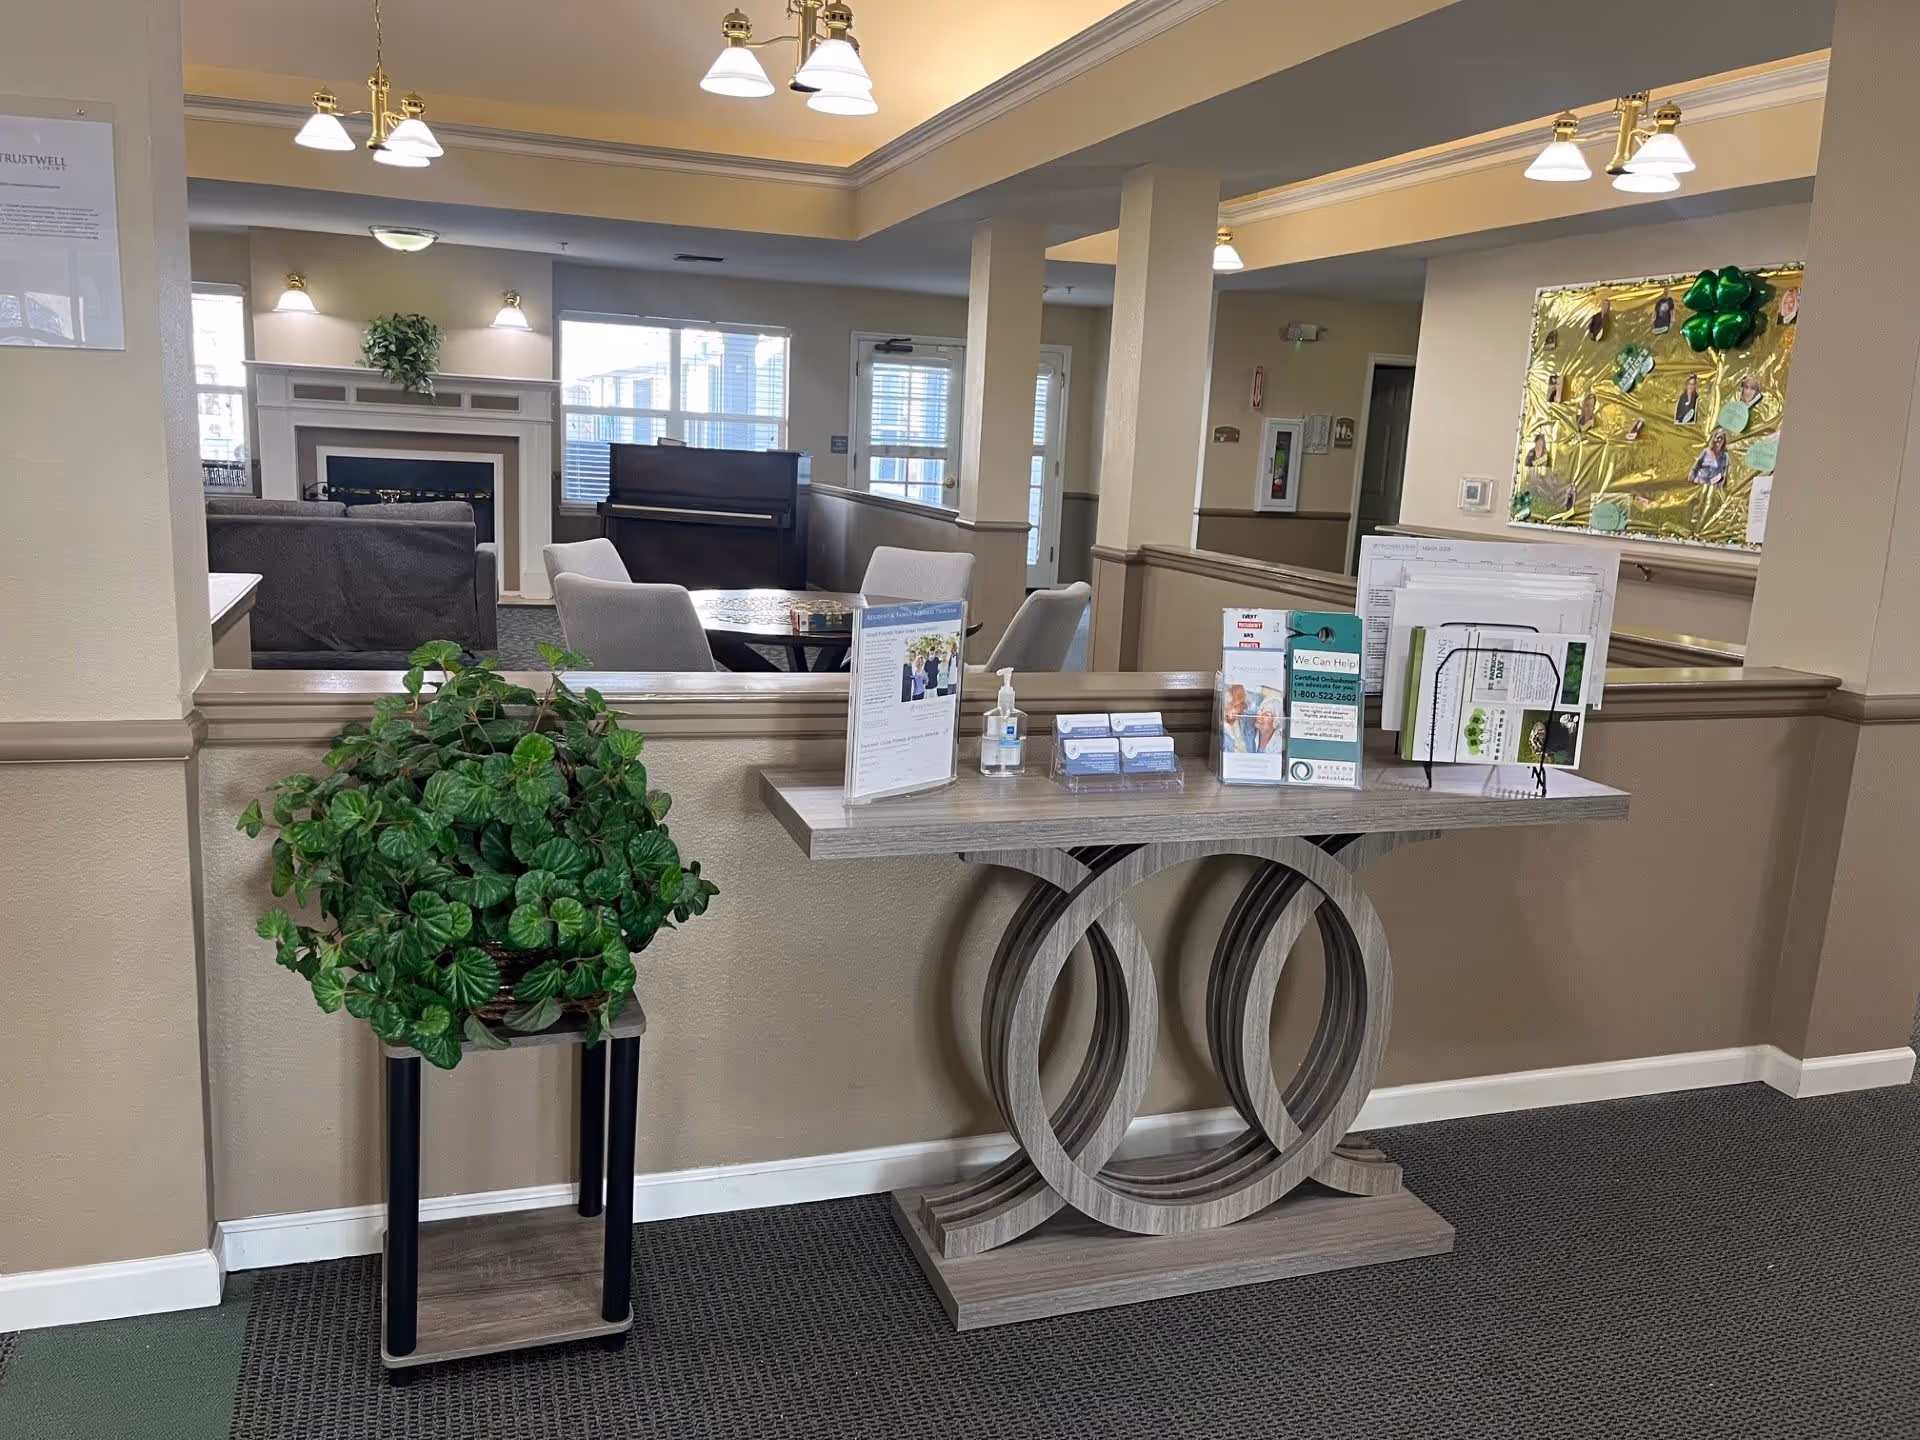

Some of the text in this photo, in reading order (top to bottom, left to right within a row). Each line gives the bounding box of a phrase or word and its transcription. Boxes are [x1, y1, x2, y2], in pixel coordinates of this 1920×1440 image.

[0, 152, 67, 166] TRUSTWELL
[1294, 655, 1309, 664] We
[1312, 656, 1331, 666] Can
[1489, 648, 1498, 680] PATRICK
[1496, 660, 1504, 679] DAY
[1293, 690, 1356, 701] 1-800-522-2602
